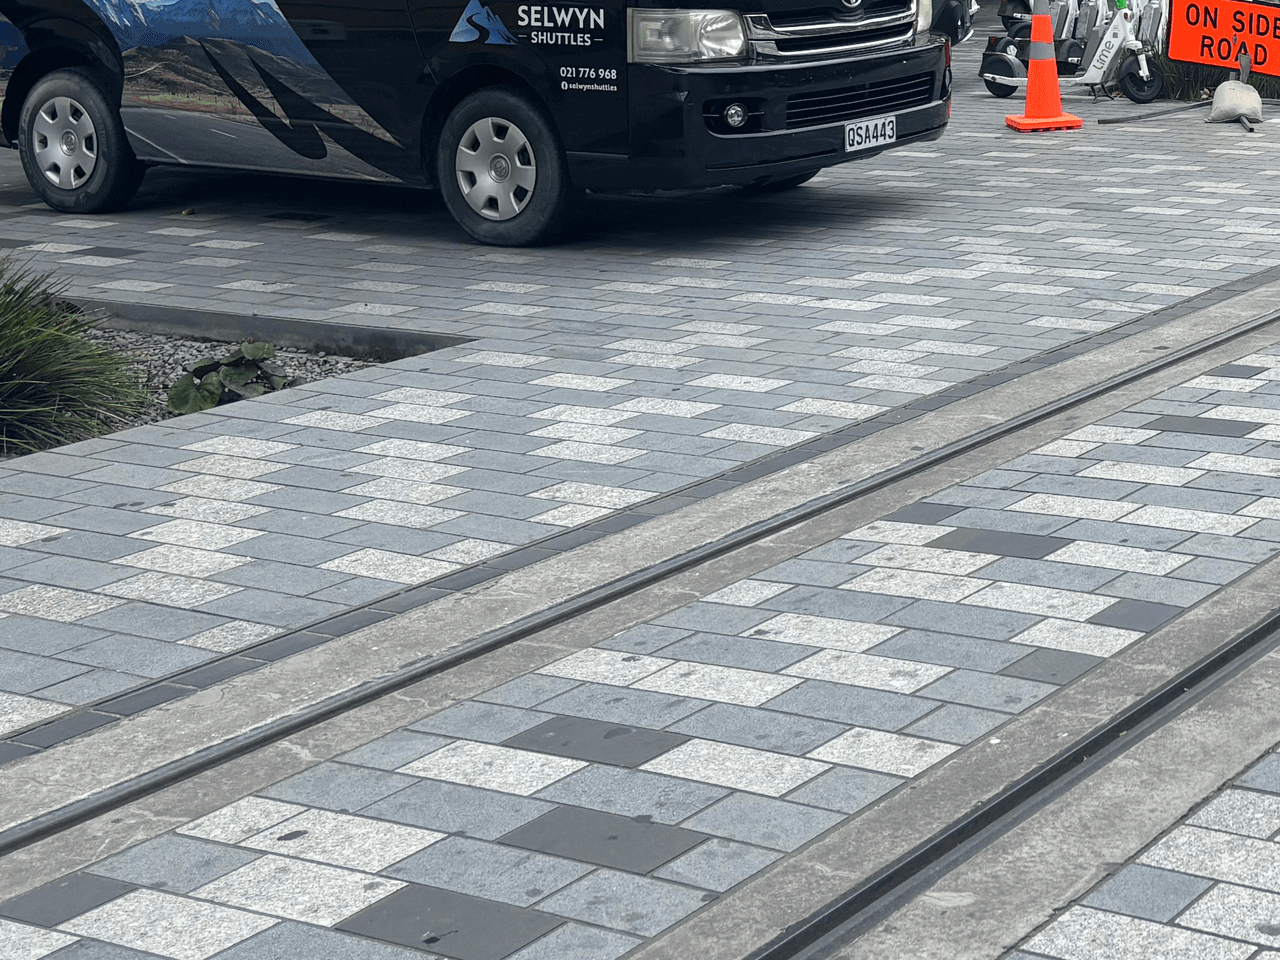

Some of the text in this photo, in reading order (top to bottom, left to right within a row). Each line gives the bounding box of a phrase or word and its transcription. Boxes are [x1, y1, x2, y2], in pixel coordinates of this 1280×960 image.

[517, 5, 604, 29] SELWYN
[1186, 3, 1218, 29] ON
[531, 31, 591, 46] SHUTTLES
[1200, 35, 1268, 66] ROAD
[560, 67, 617, 80] 021 776 968
[569, 82, 618, 92] selwynshuttles
[848, 120, 895, 147] QSA443
